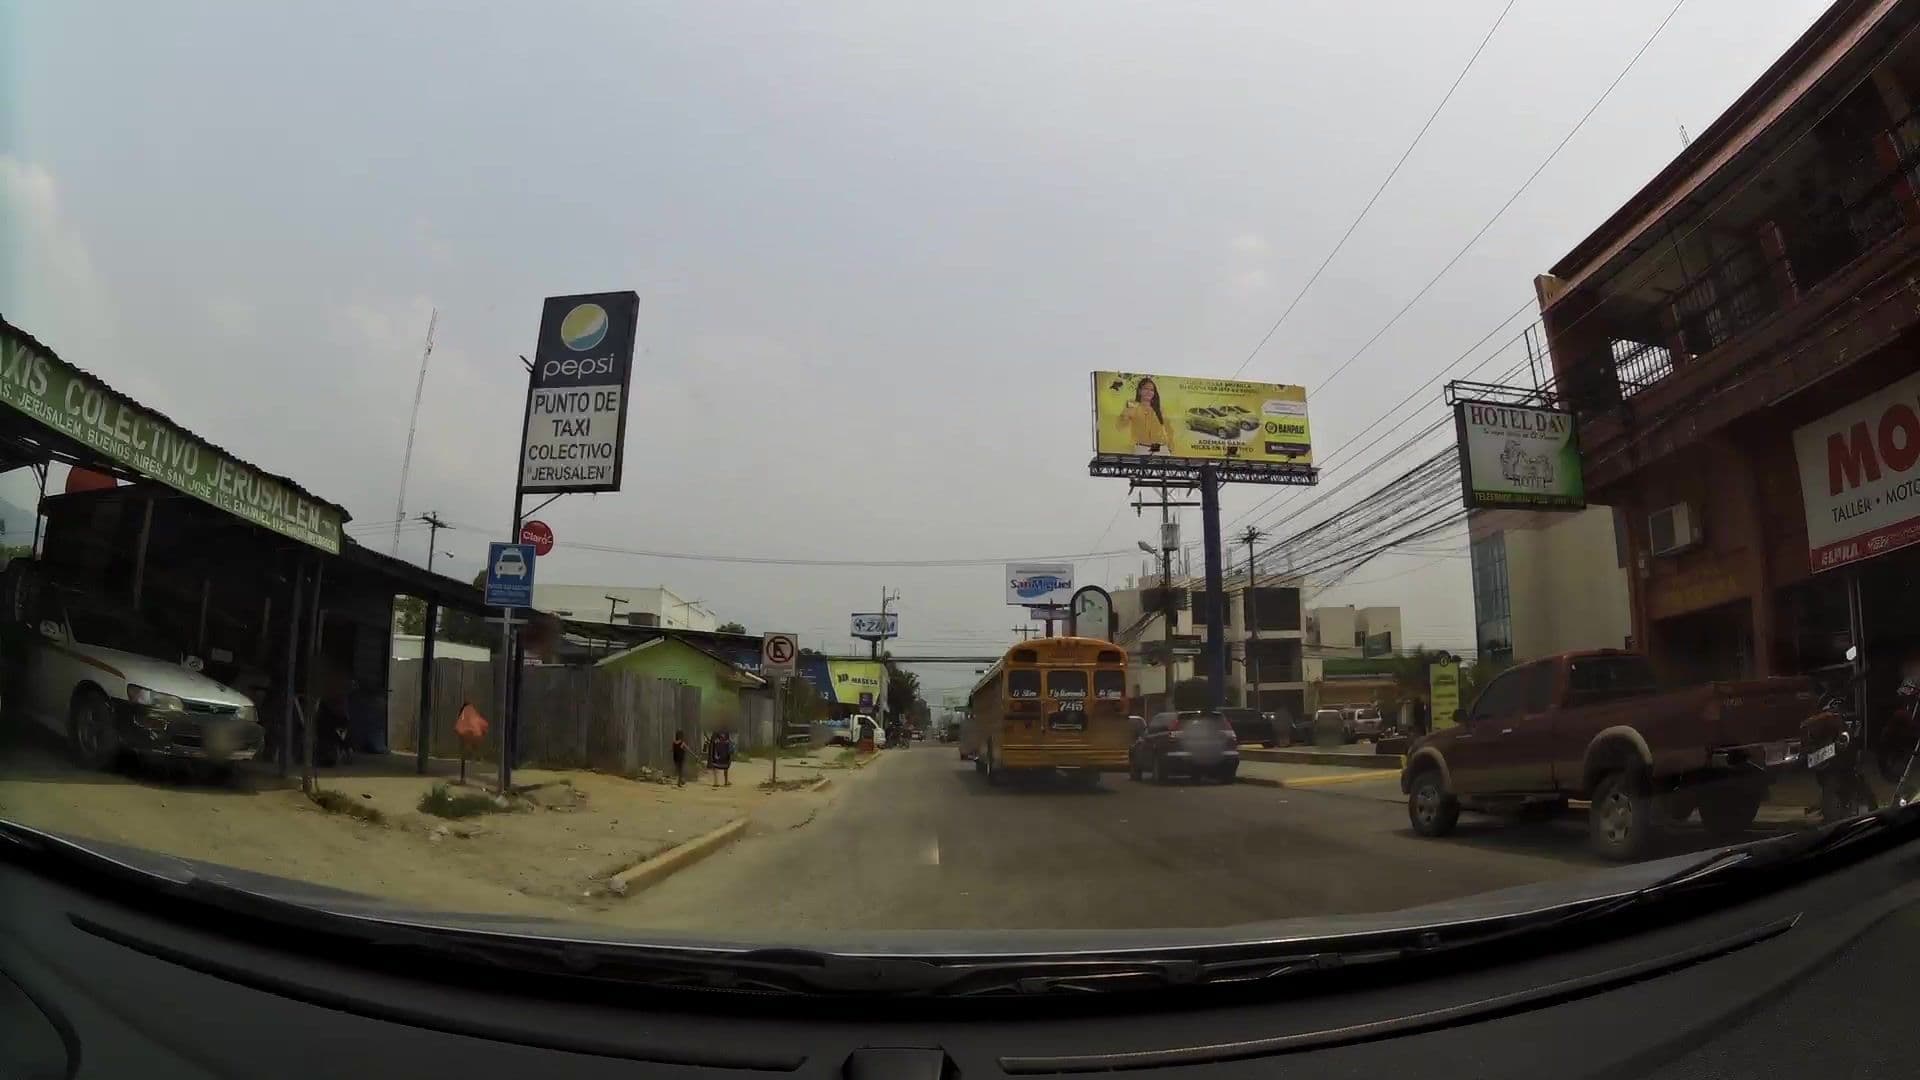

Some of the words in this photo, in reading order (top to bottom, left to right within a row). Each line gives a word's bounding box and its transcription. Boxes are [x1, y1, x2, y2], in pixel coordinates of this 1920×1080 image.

[543, 353, 614, 381] pepsi
[534, 392, 590, 414] PUNTO
[594, 391, 617, 412] DE
[552, 418, 590, 437] TAXI
[1471, 406, 1533, 430] HOTEL
[65, 377, 201, 476] COLECTIVO
[206, 456, 321, 533] JERUSALEM
[87, 427, 131, 460] BUENOS
[167, 468, 186, 487] SAN
[528, 443, 612, 461] COLECTIVO
[1832, 498, 1872, 523] TALLER
[523, 530, 549, 545] Claro
